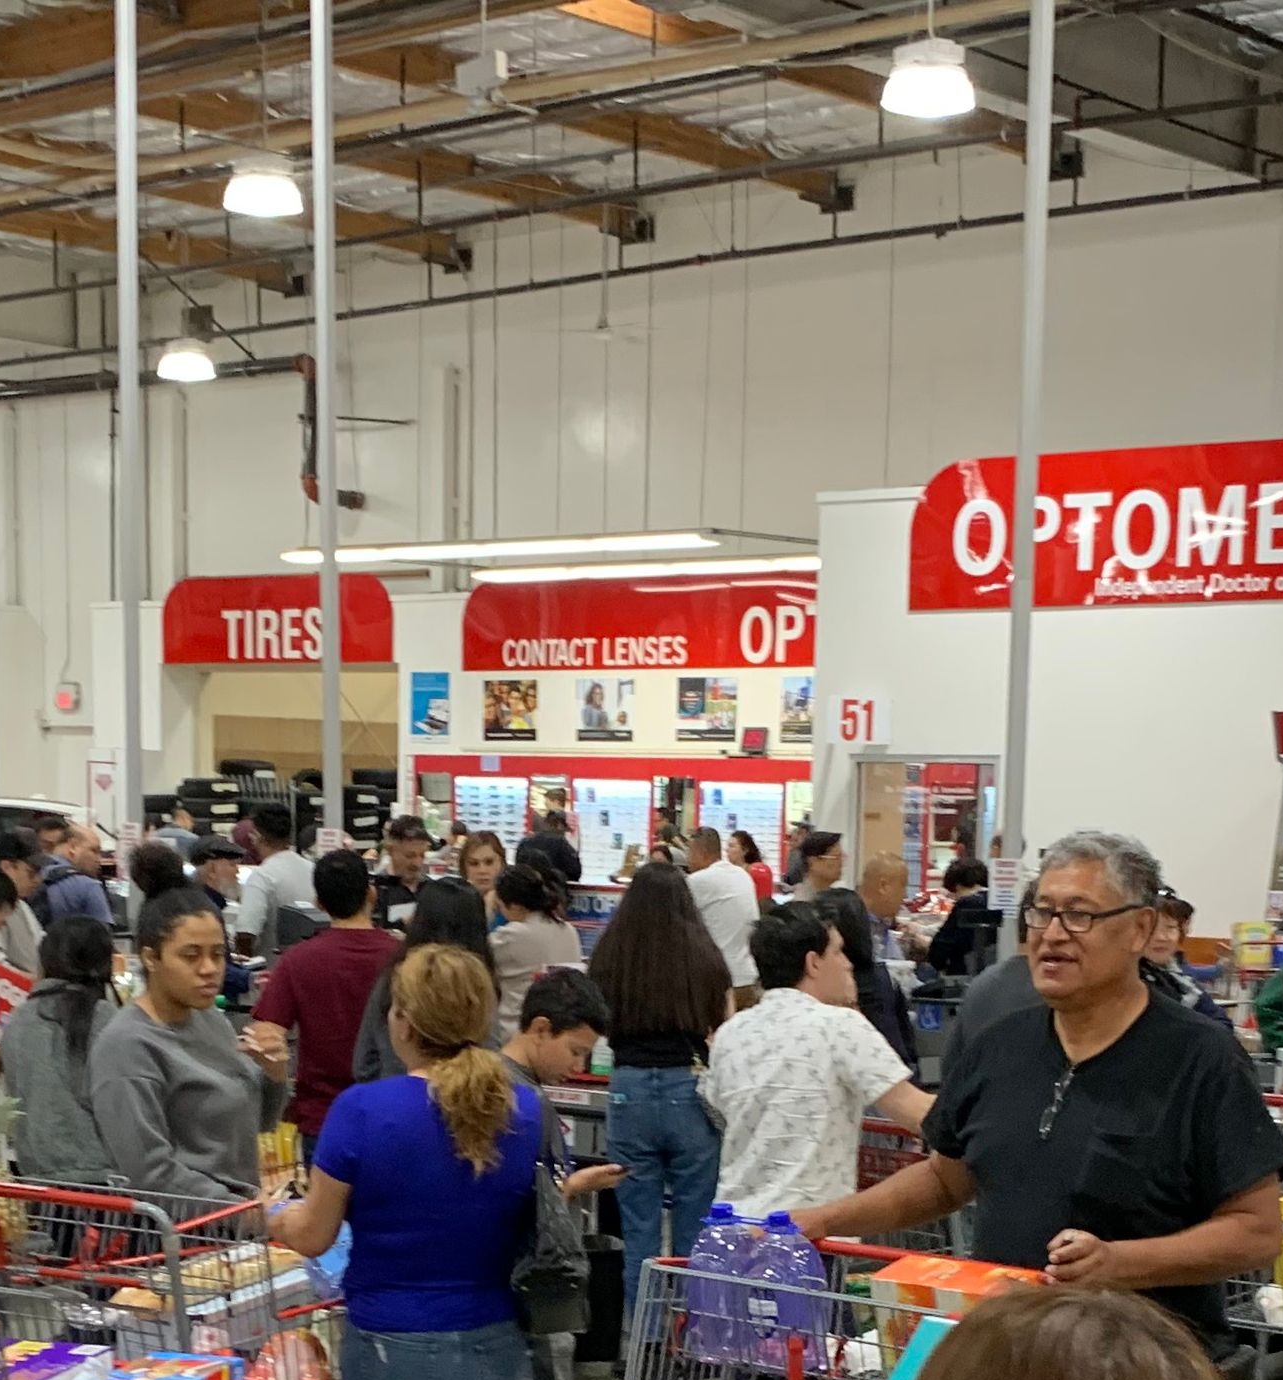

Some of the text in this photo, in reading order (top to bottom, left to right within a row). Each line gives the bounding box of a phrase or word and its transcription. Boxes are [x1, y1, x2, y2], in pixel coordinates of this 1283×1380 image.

[1211, 572, 1271, 593] Doctor
[221, 607, 325, 660] TIRES
[501, 634, 689, 668] CONTACT LENSES
[840, 698, 875, 742] 51
